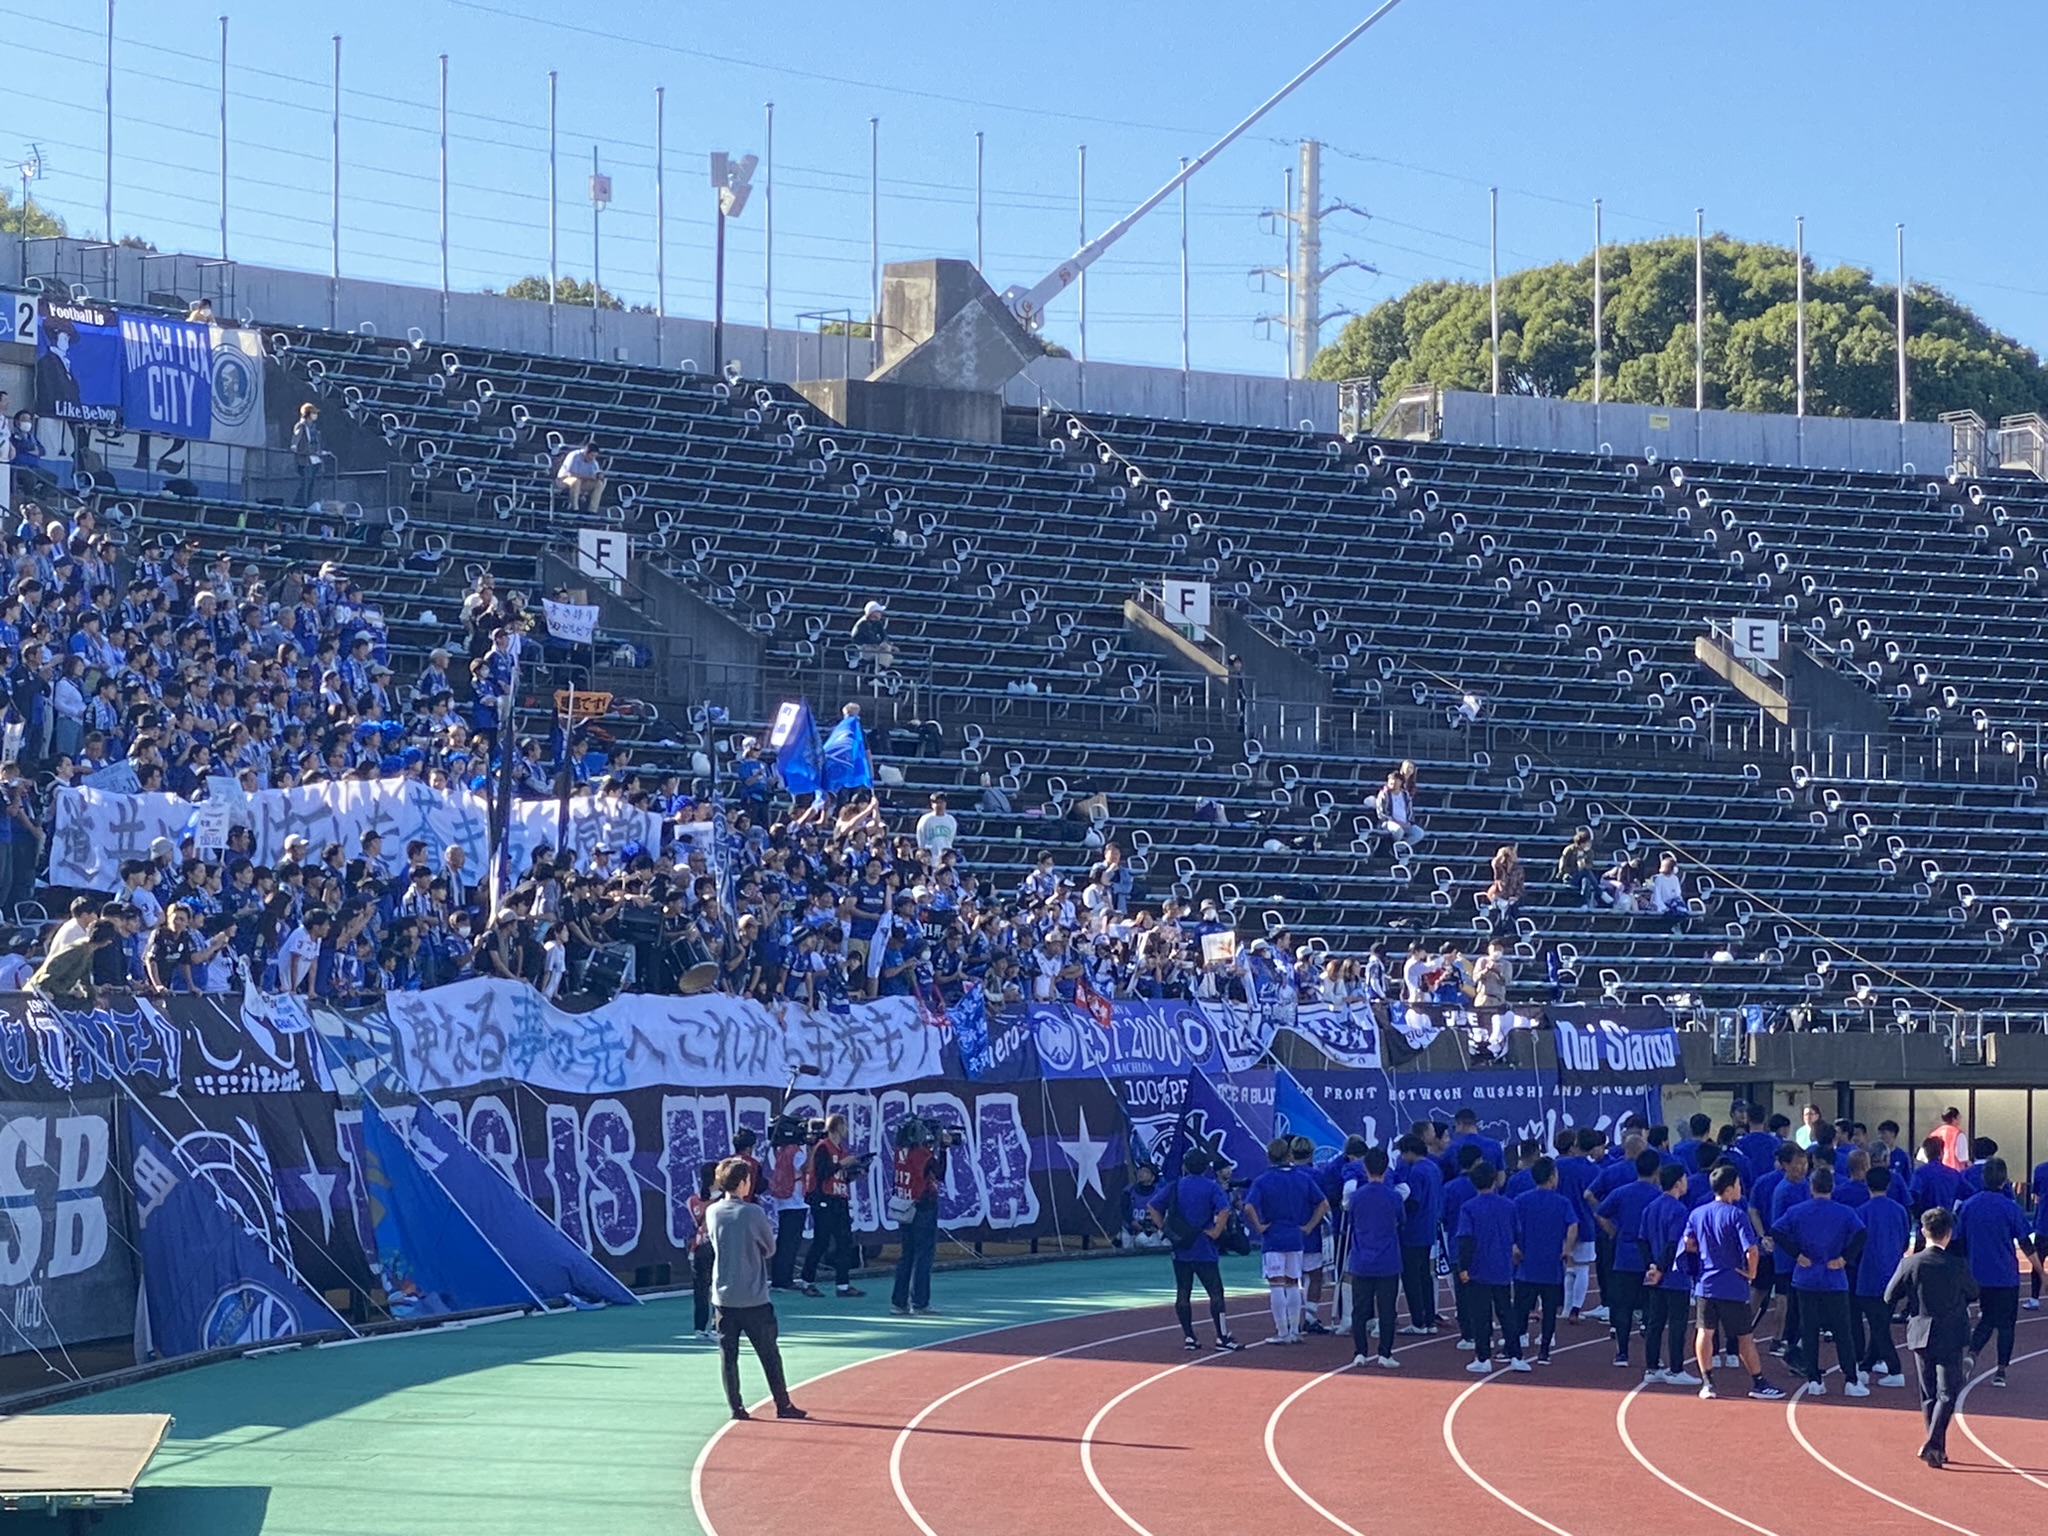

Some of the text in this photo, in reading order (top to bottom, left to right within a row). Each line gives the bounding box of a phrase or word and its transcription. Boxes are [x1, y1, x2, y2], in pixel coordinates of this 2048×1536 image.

[18, 302, 35, 339] 2
[94, 310, 105, 326] is
[122, 319, 212, 385] MACHIDA
[147, 366, 196, 427] CITY
[55, 400, 117, 424] Like Bebop
[596, 538, 612, 570] F
[1180, 588, 1196, 616] F
[1749, 625, 1765, 652] E
[1323, 1086, 1378, 1100] FRONT
[1473, 1085, 1543, 1098] MUSASHI
[545, 1094, 644, 1257] IS
